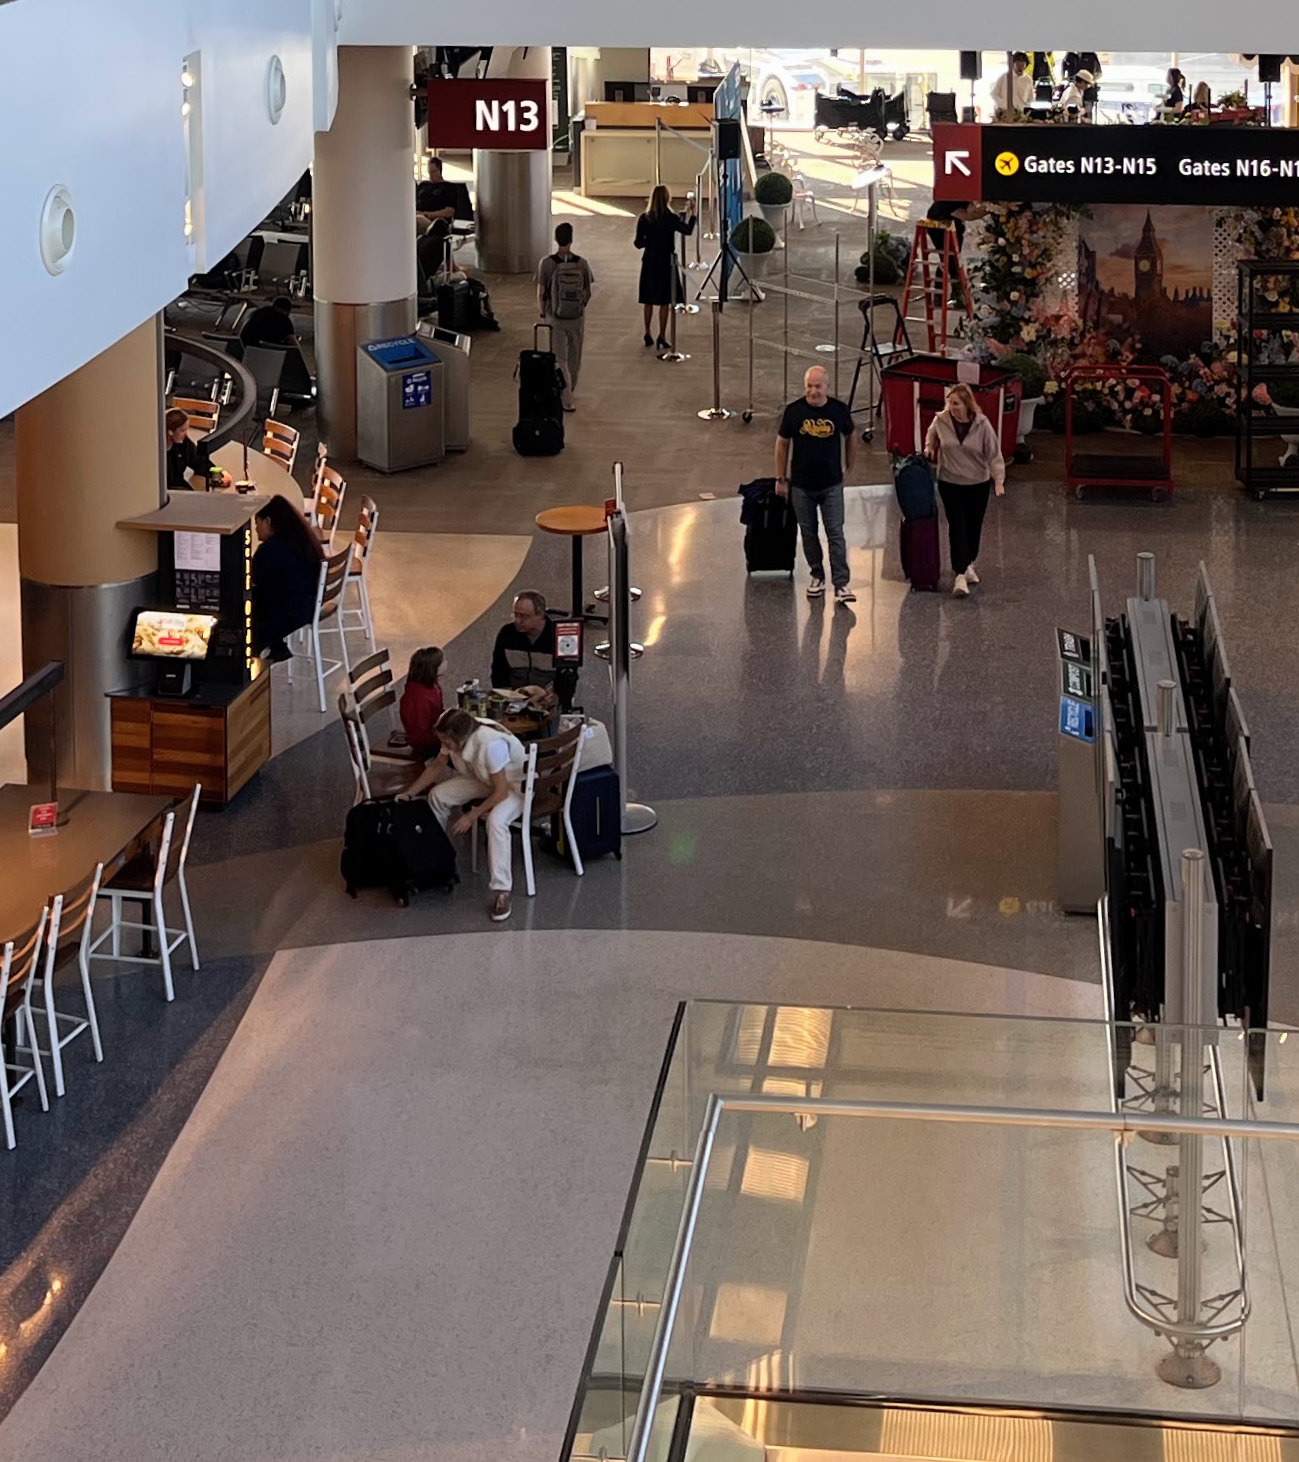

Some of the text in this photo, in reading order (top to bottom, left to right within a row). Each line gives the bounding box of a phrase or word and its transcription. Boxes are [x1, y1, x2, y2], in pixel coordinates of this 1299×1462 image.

[475, 99, 539, 132] N13
[1023, 155, 1157, 175] Gates N13-N15
[1178, 158, 1231, 177] Gates
